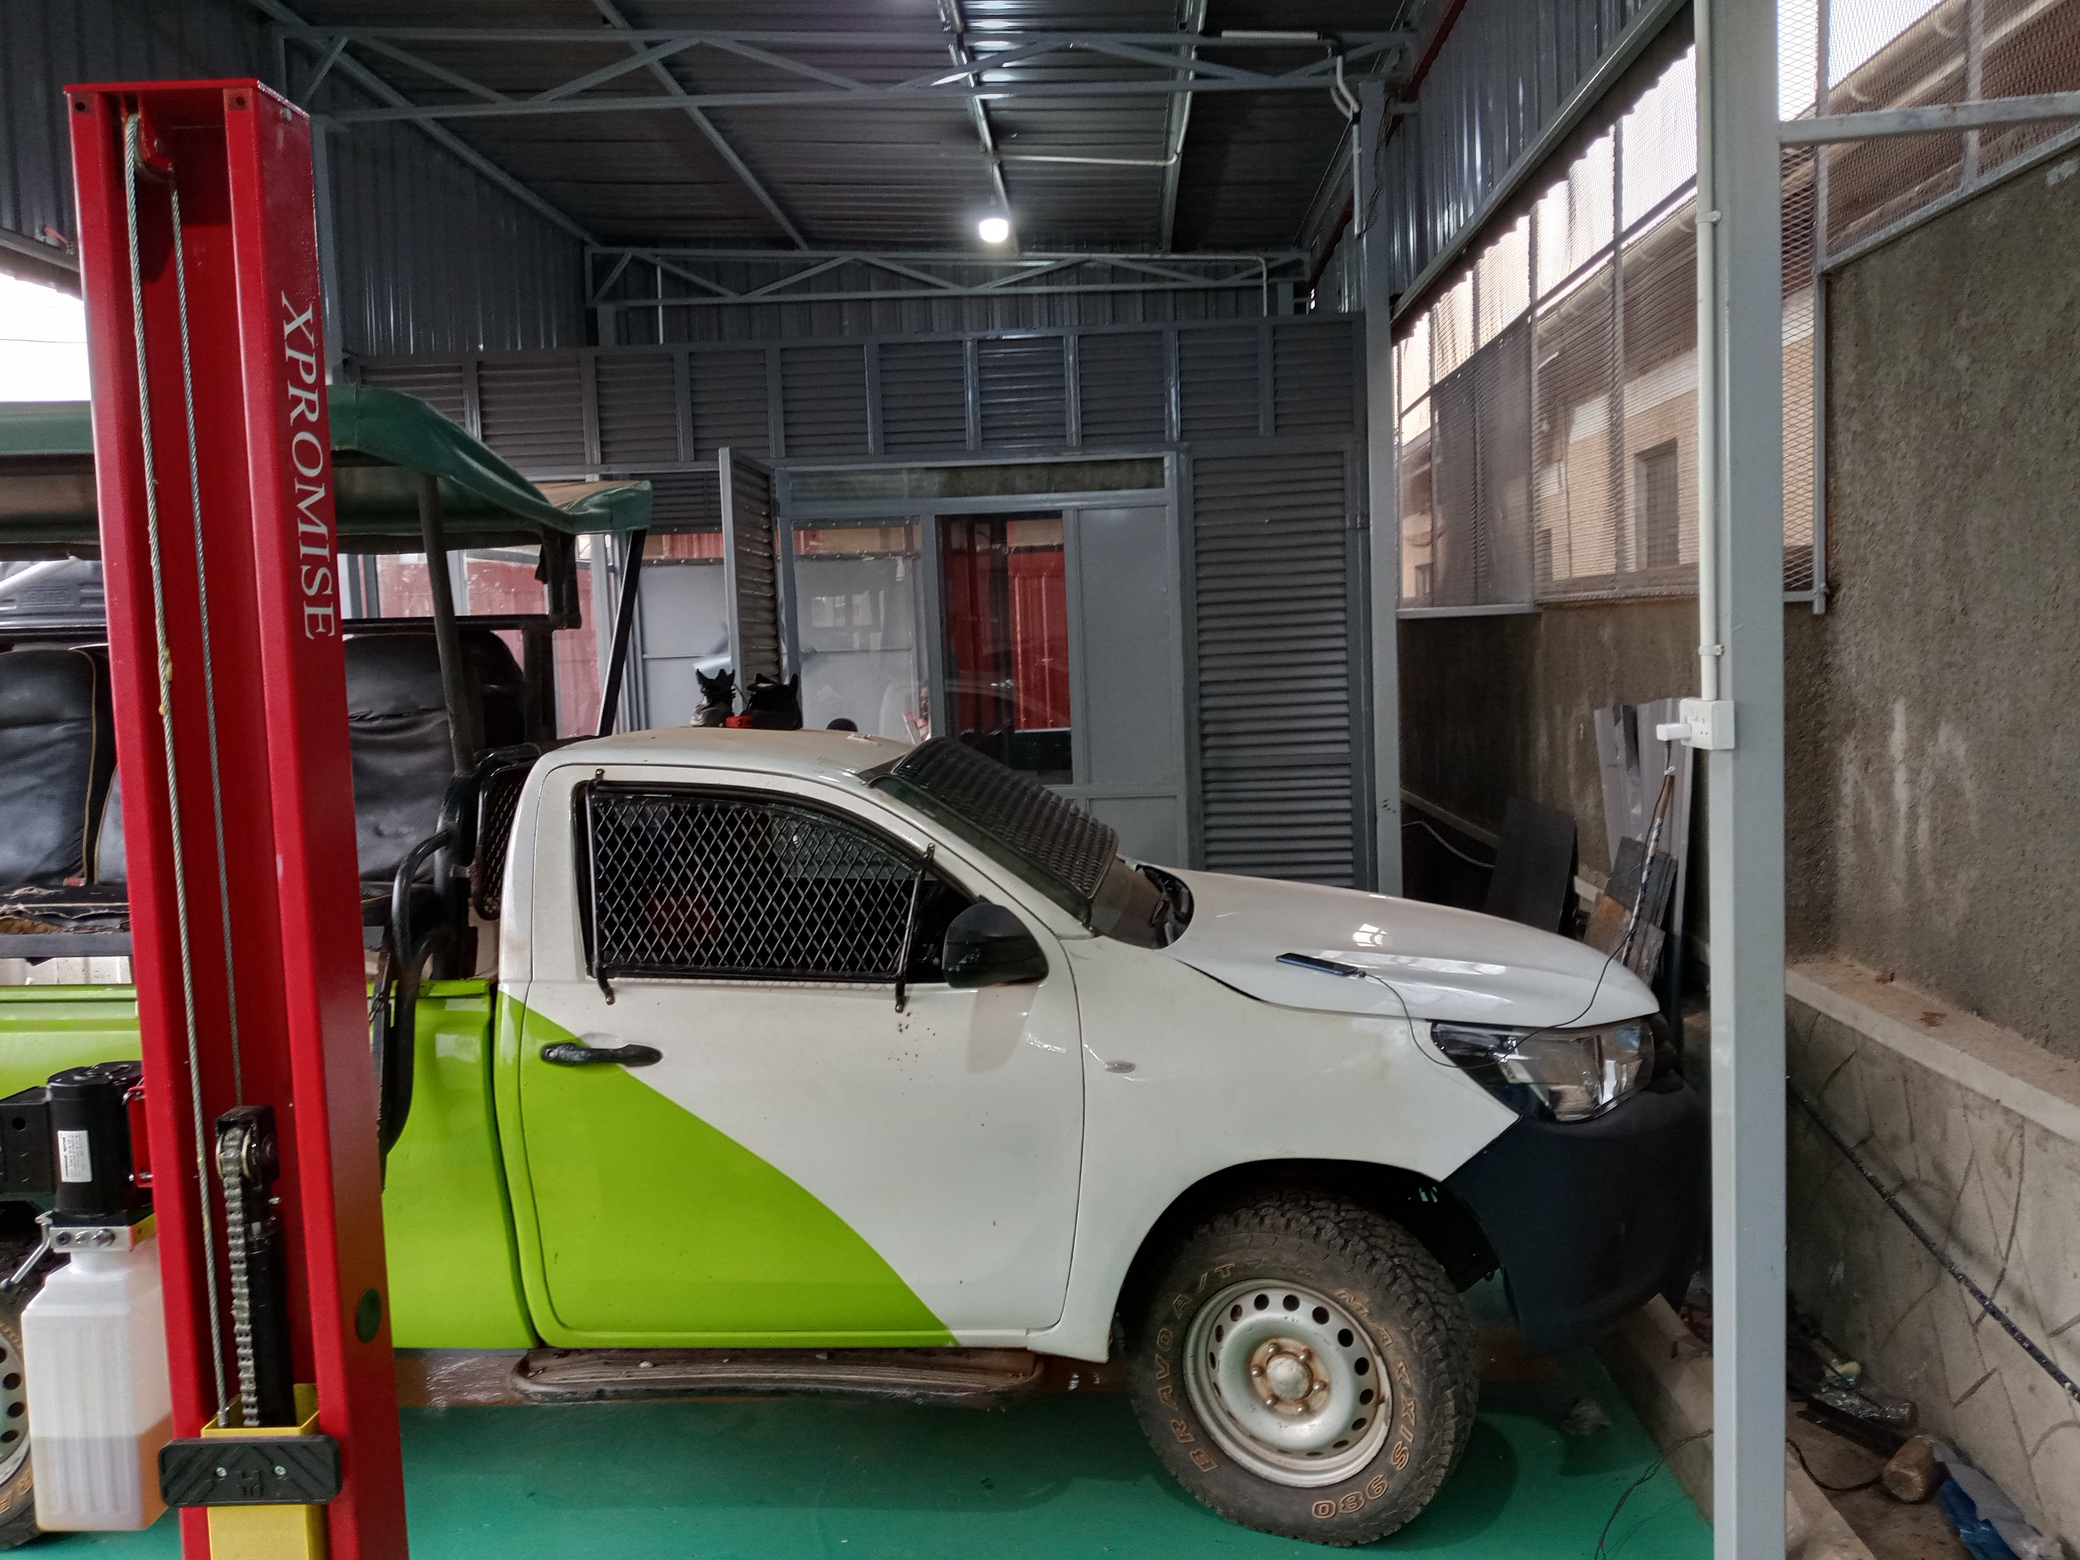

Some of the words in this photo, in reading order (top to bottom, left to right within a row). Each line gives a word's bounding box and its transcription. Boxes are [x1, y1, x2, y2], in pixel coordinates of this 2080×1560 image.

[281, 290, 336, 640] XPROMISE
[1172, 1263, 1236, 1320] A/T
[1155, 1327, 1219, 1473] BRAVO
[1334, 1288, 1416, 1471] MAXXIS
[1312, 1474, 1389, 1519] 980
